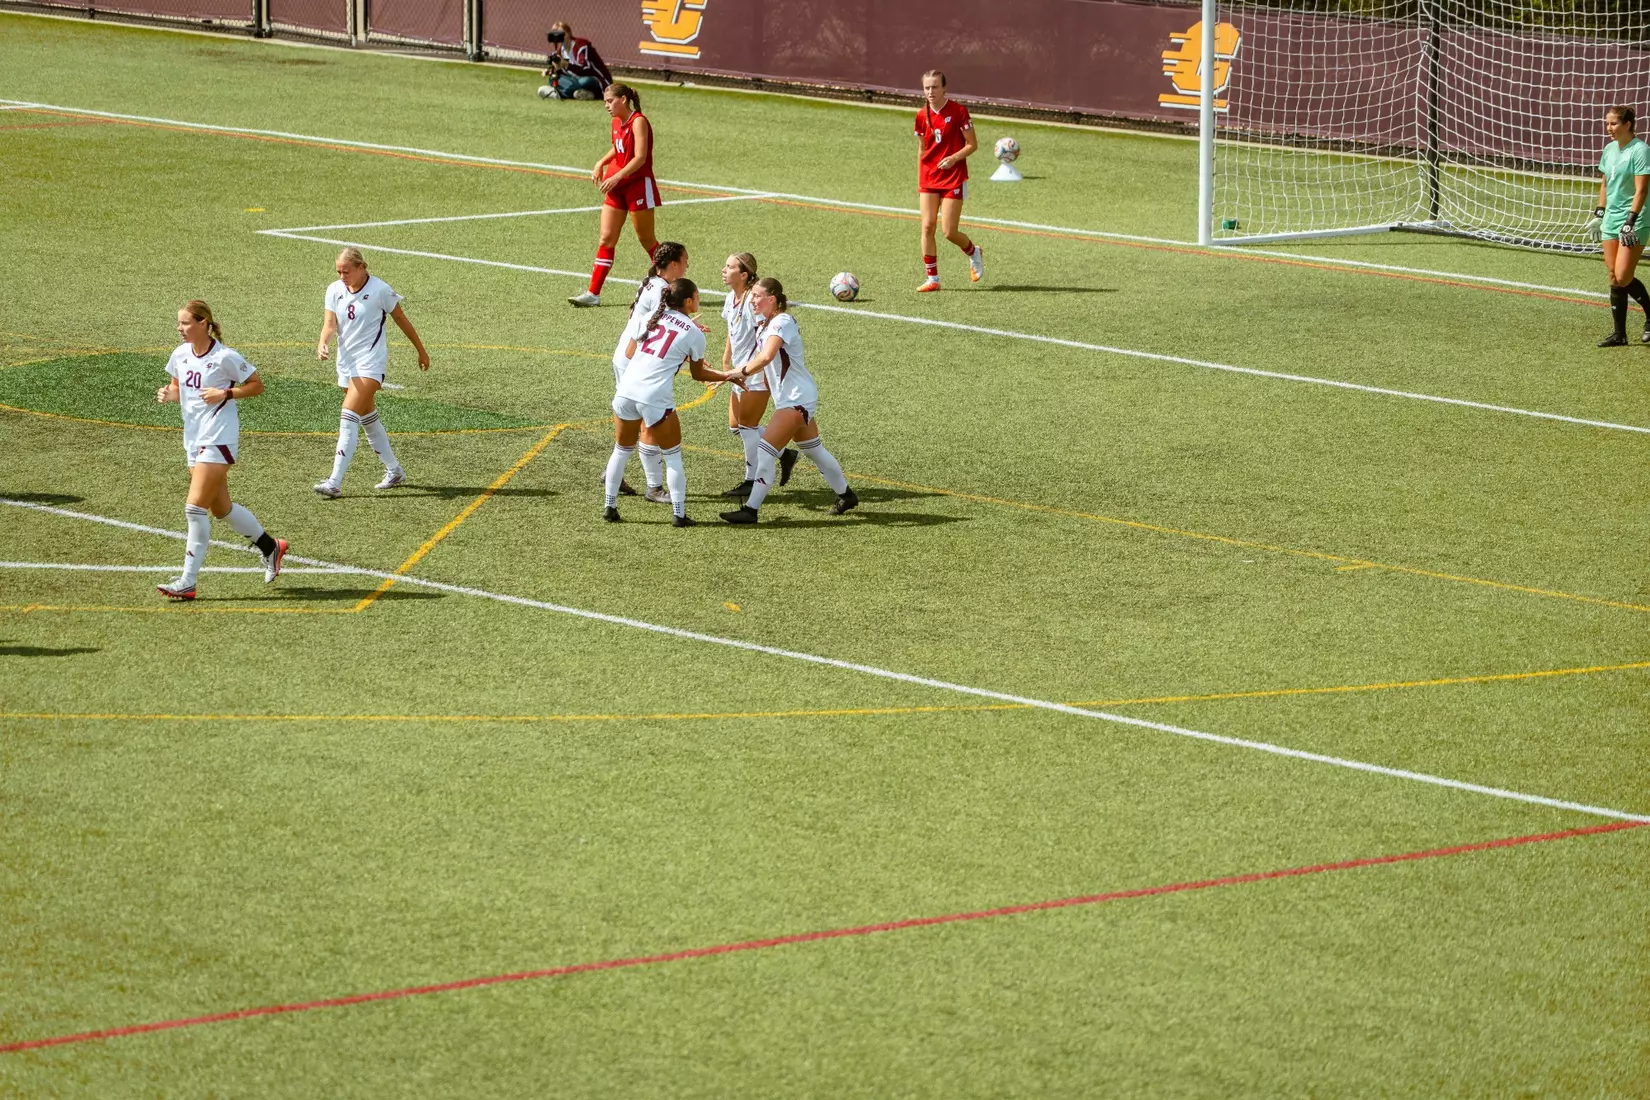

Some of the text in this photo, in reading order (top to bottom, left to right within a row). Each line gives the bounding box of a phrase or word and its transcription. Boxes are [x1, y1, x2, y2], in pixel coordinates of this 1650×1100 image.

[934, 128, 942, 144] 6
[615, 138, 625, 154] 14
[347, 304, 356, 321] 8
[659, 313, 691, 332] IPPEWAS
[641, 323, 679, 360] 21
[186, 370, 202, 389] 20
